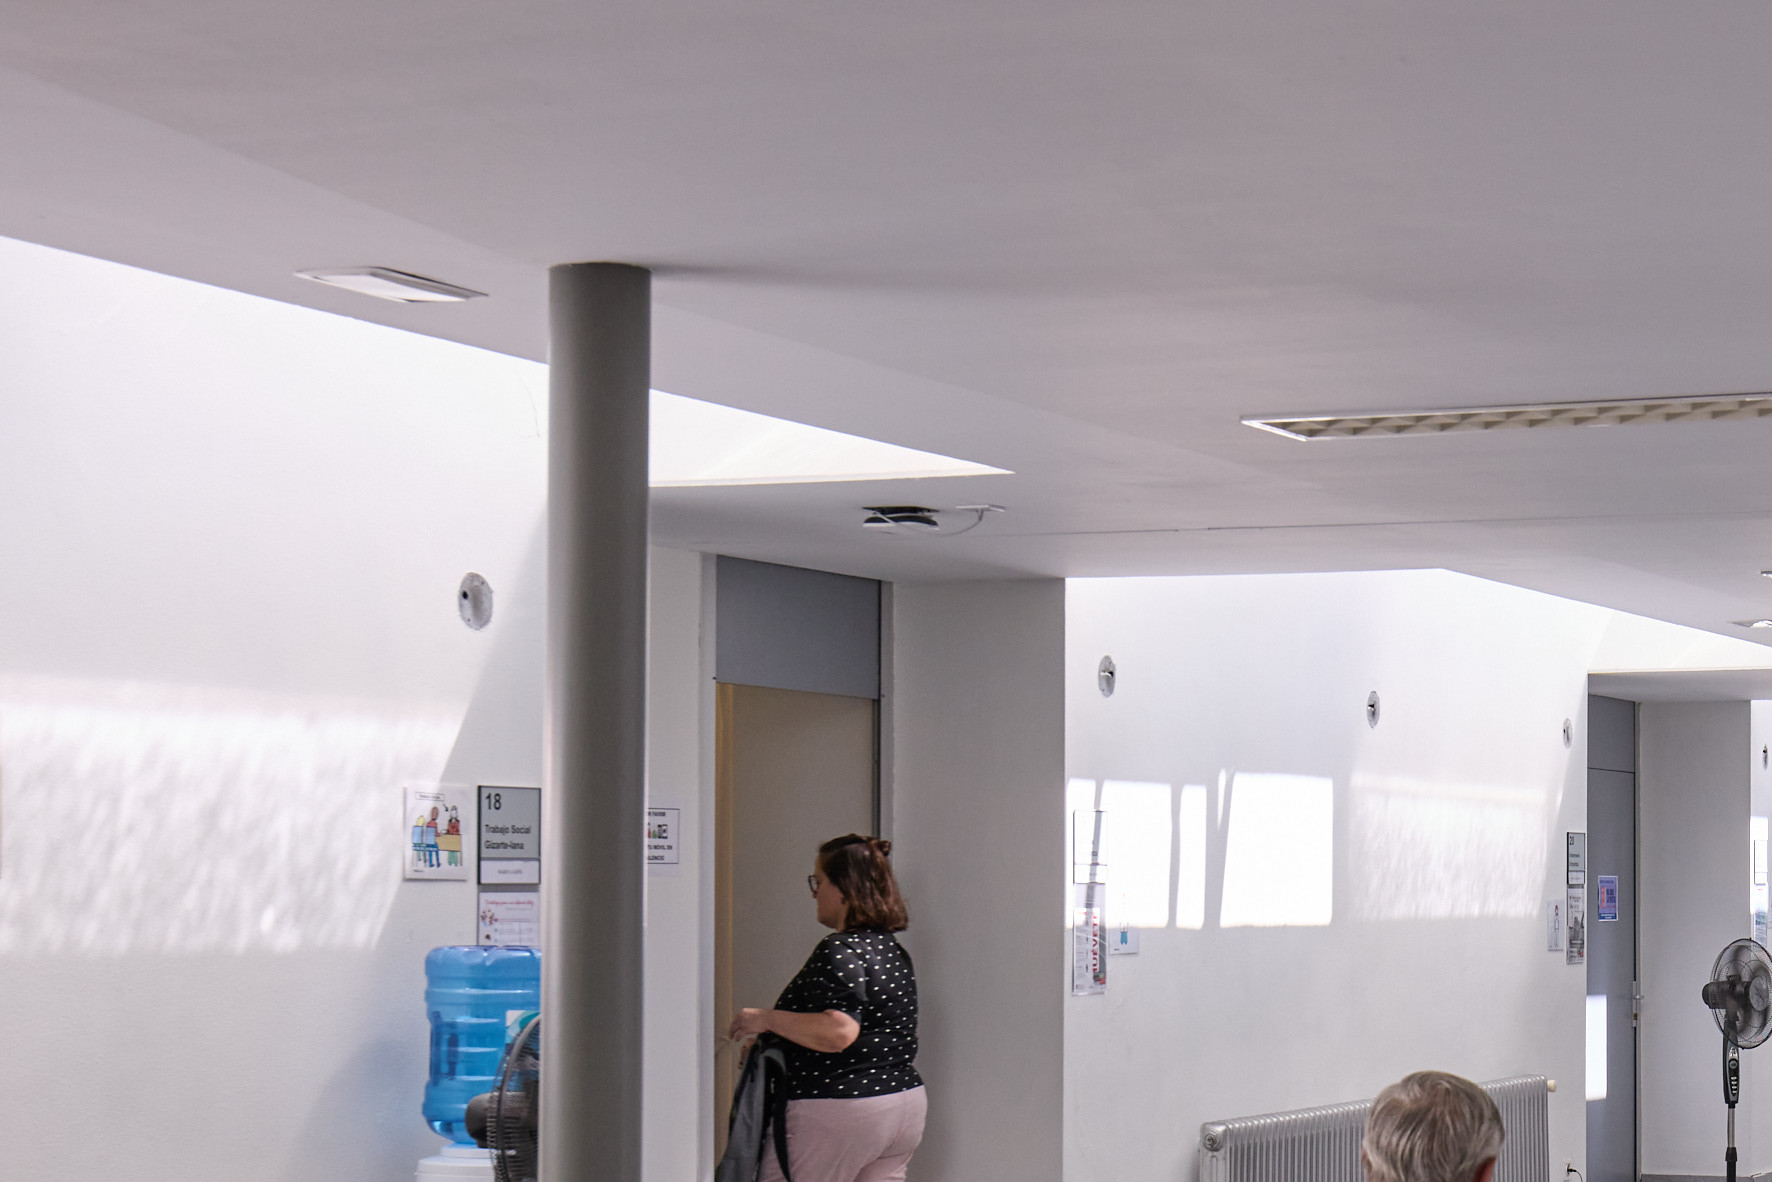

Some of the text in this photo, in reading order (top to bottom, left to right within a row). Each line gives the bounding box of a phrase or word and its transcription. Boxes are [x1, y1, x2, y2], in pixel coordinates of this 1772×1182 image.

[485, 793, 502, 810] 18
[485, 824, 531, 835] Trabajo Social
